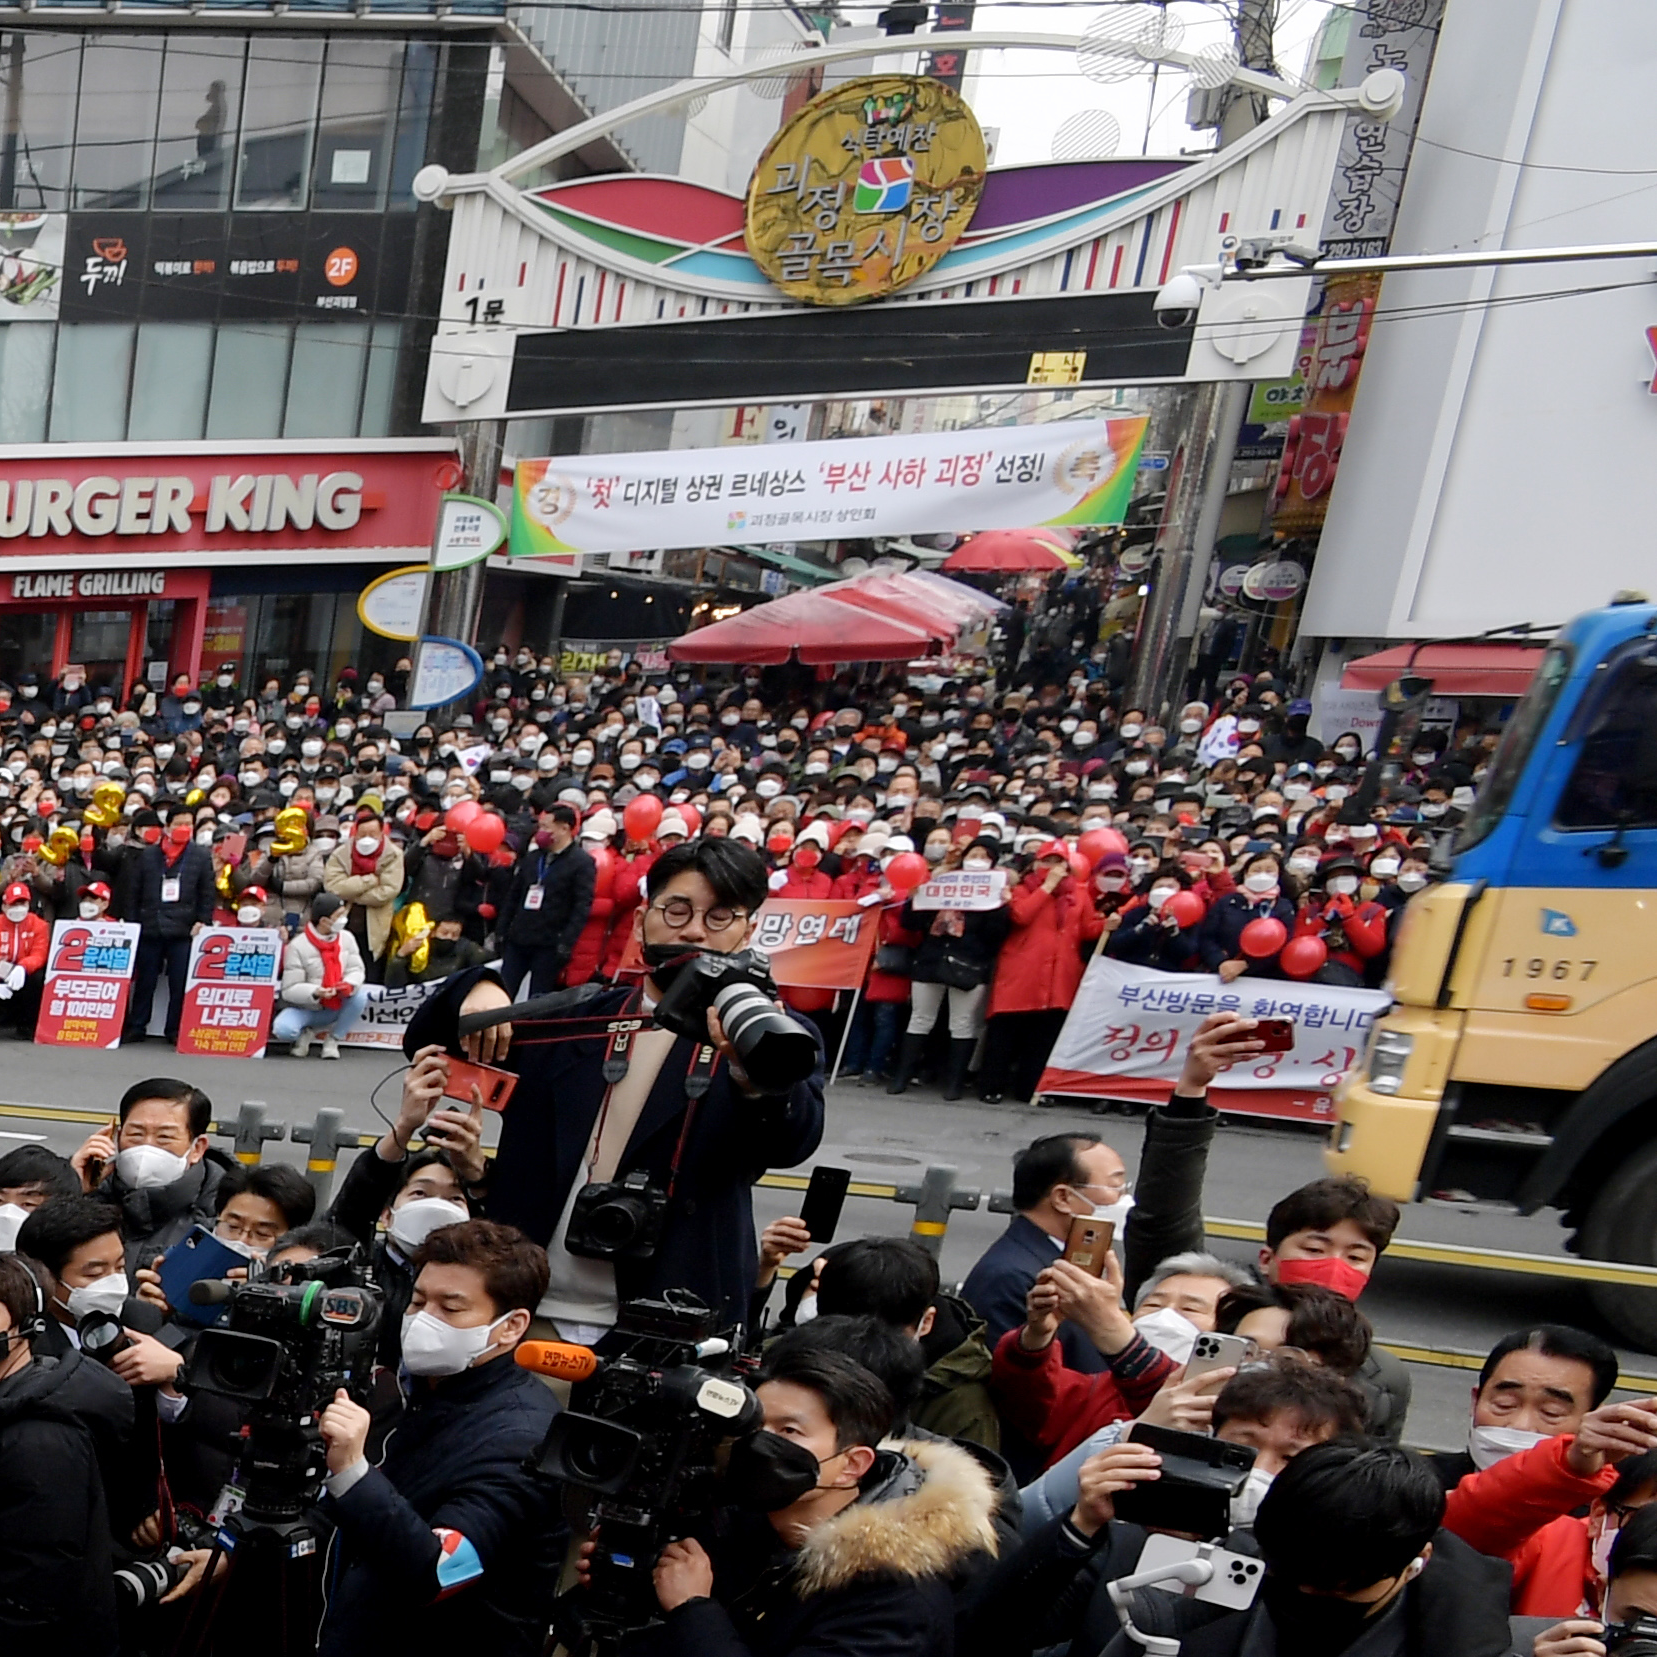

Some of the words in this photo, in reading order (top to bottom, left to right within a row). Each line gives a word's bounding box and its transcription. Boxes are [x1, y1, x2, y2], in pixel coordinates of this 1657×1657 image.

[840, 120, 936, 157] 식탁예찬
[1334, 44, 1408, 233] 노연습장
[328, 256, 353, 278] 2F
[464, 296, 506, 325] 1문
[623, 477, 678, 506] 디지털
[686, 474, 724, 501] 상권
[728, 469, 807, 498] 르네상스
[878, 457, 927, 490] 사하
[994, 453, 1046, 484] 선정!
[204, 471, 364, 534] KING
[750, 511, 832, 527] 괴정골목시장
[836, 508, 876, 523] 상인회
[12, 574, 75, 598] FLAME
[79, 570, 166, 596] GRILLING
[925, 883, 991, 899] 대한민국
[753, 913, 864, 947] 망연대
[51, 927, 92, 971] 2
[83, 946, 131, 969] 윤석열
[192, 935, 235, 979] 2
[224, 952, 276, 976] 윤석열
[1501, 957, 1600, 982] 1967
[53, 979, 121, 1001] 부모급여
[195, 987, 254, 1006] 임대료
[1117, 984, 1242, 1017] 부산방문을
[66, 1000, 117, 1019] 100만원
[200, 1009, 262, 1028] 나눔제
[1102, 1024, 1181, 1065] 정의
[326, 1297, 359, 1320] SBS
[541, 1348, 593, 1372] 연합뉴스TV
